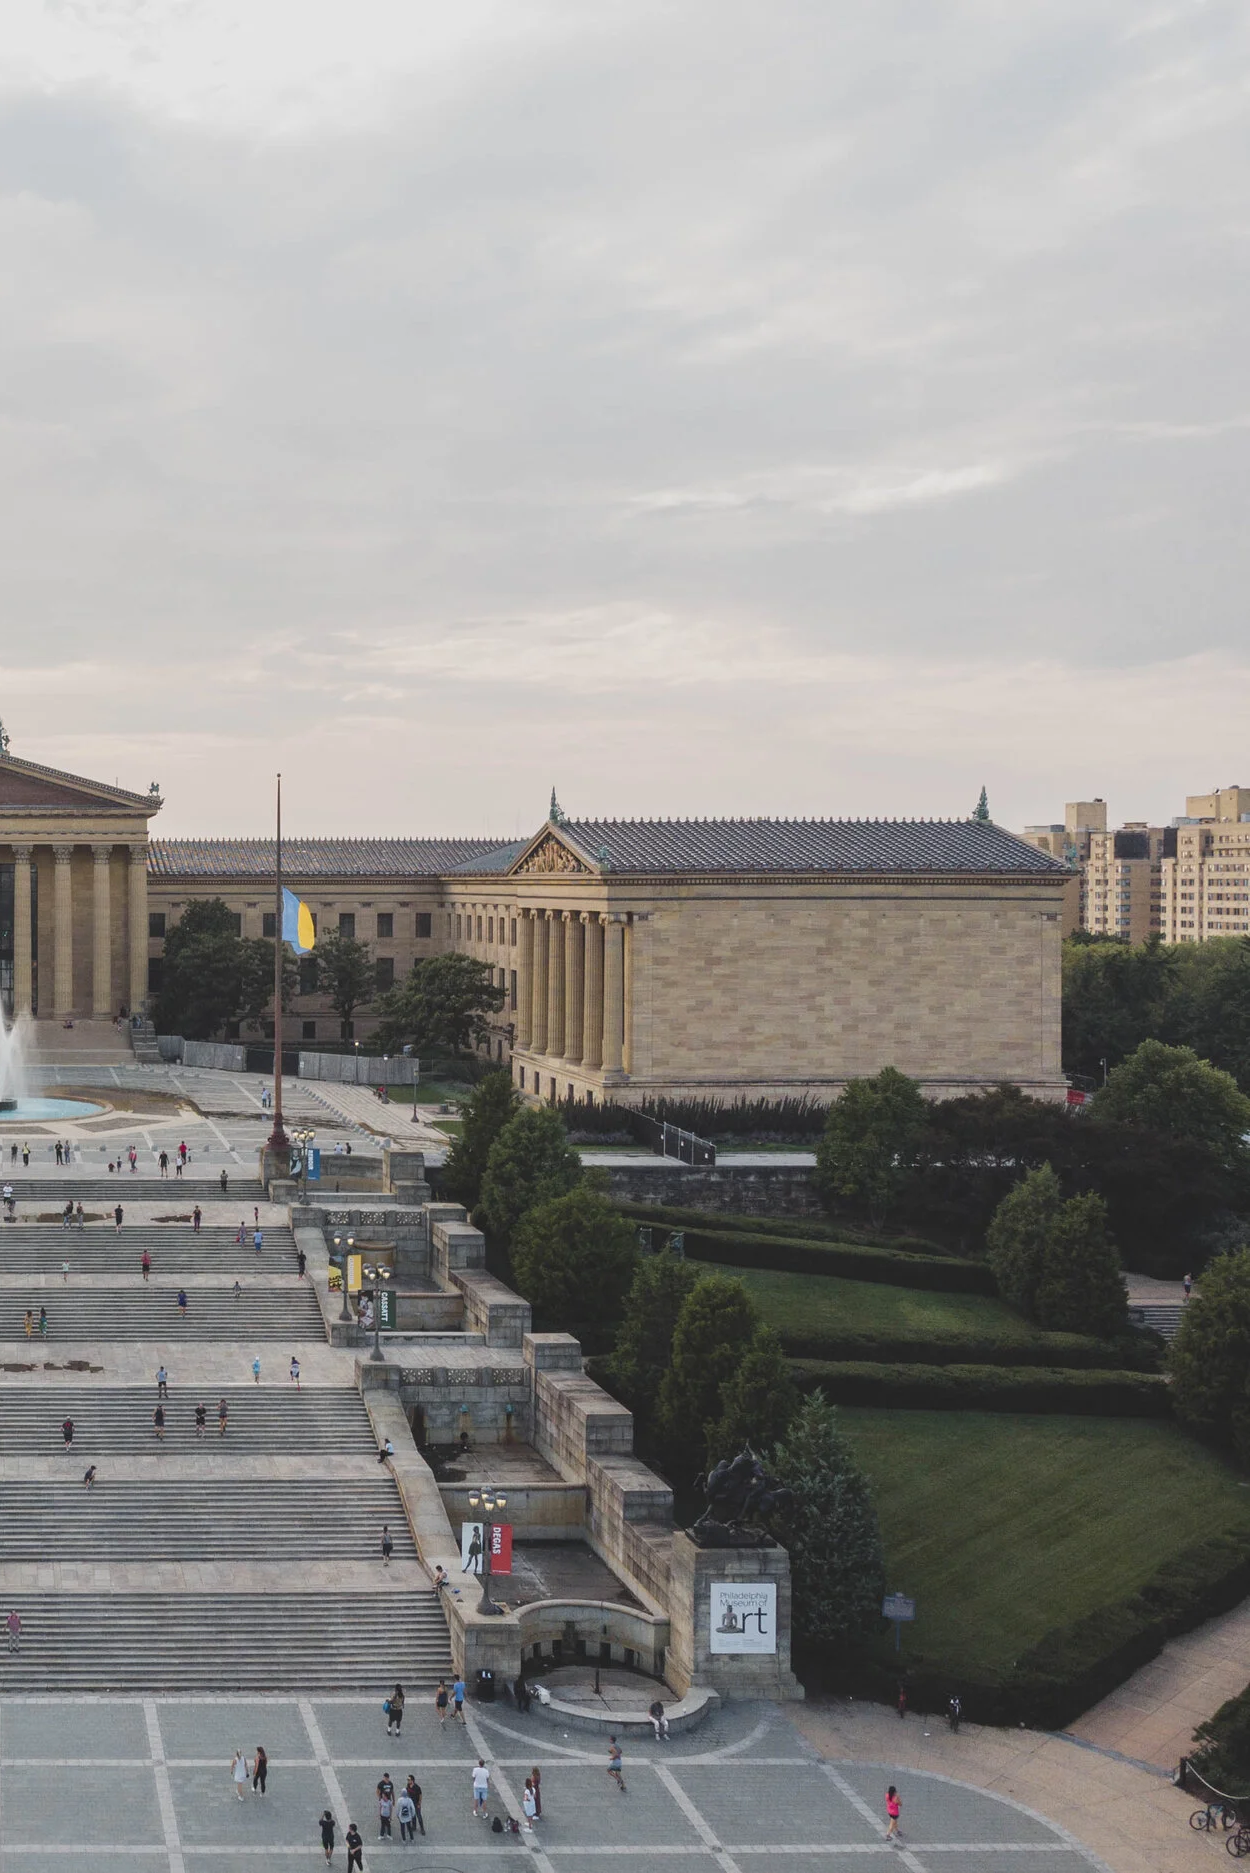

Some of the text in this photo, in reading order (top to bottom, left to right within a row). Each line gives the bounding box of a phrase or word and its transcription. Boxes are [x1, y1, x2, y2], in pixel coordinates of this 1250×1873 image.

[381, 1291, 389, 1322] CASSATT
[492, 1527, 502, 1554] DEGAS
[719, 1592, 768, 1600] Philadelphia
